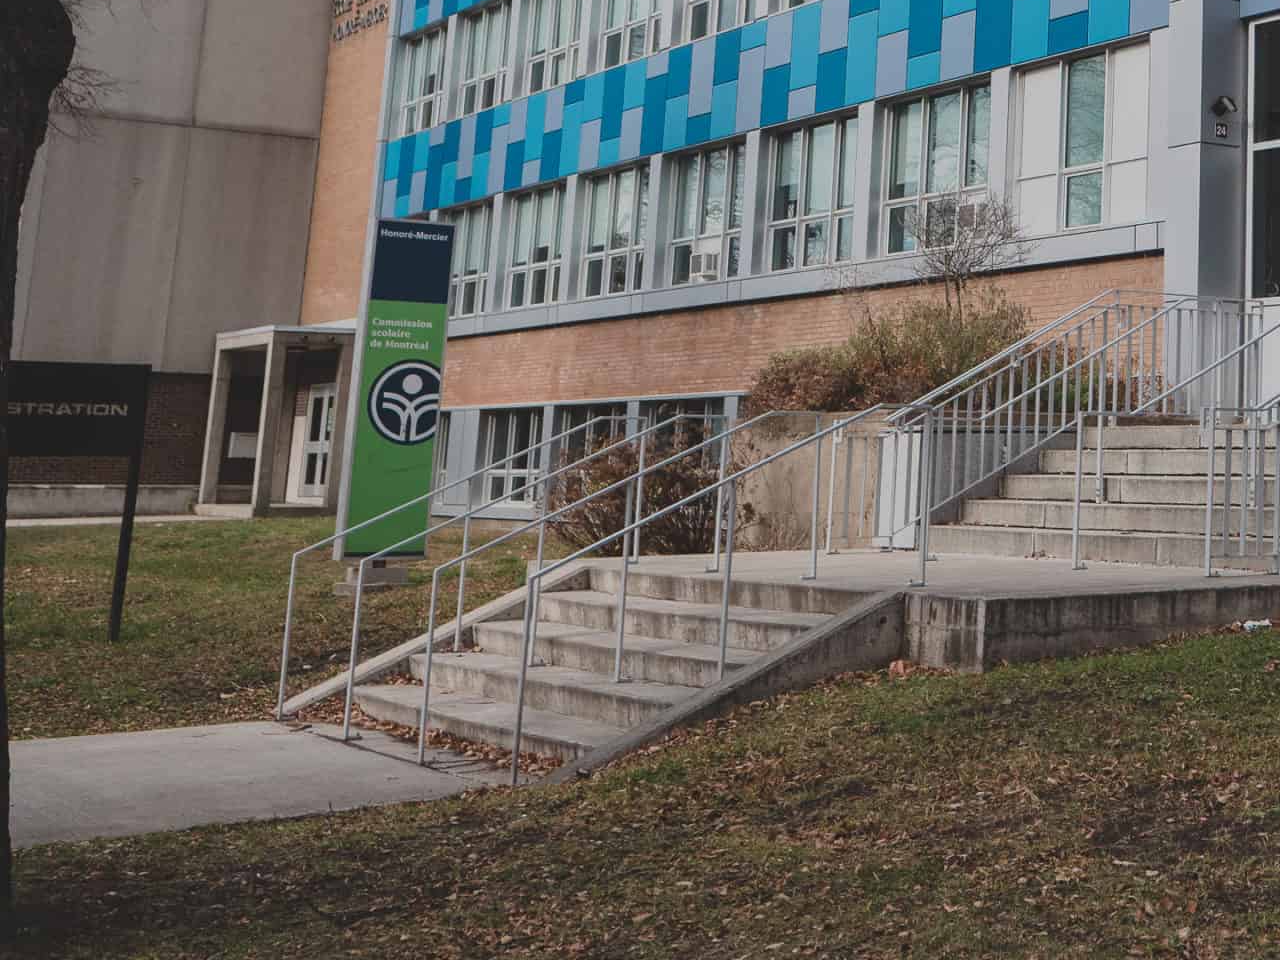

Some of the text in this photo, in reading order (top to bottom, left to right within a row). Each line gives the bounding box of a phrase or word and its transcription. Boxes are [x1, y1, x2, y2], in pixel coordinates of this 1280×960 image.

[1216, 125, 1226, 135] 24
[380, 228, 449, 241] Honoré-Mercier
[372, 317, 433, 329] Commission
[371, 328, 411, 338] scolaire
[370, 339, 429, 350] de Montréal
